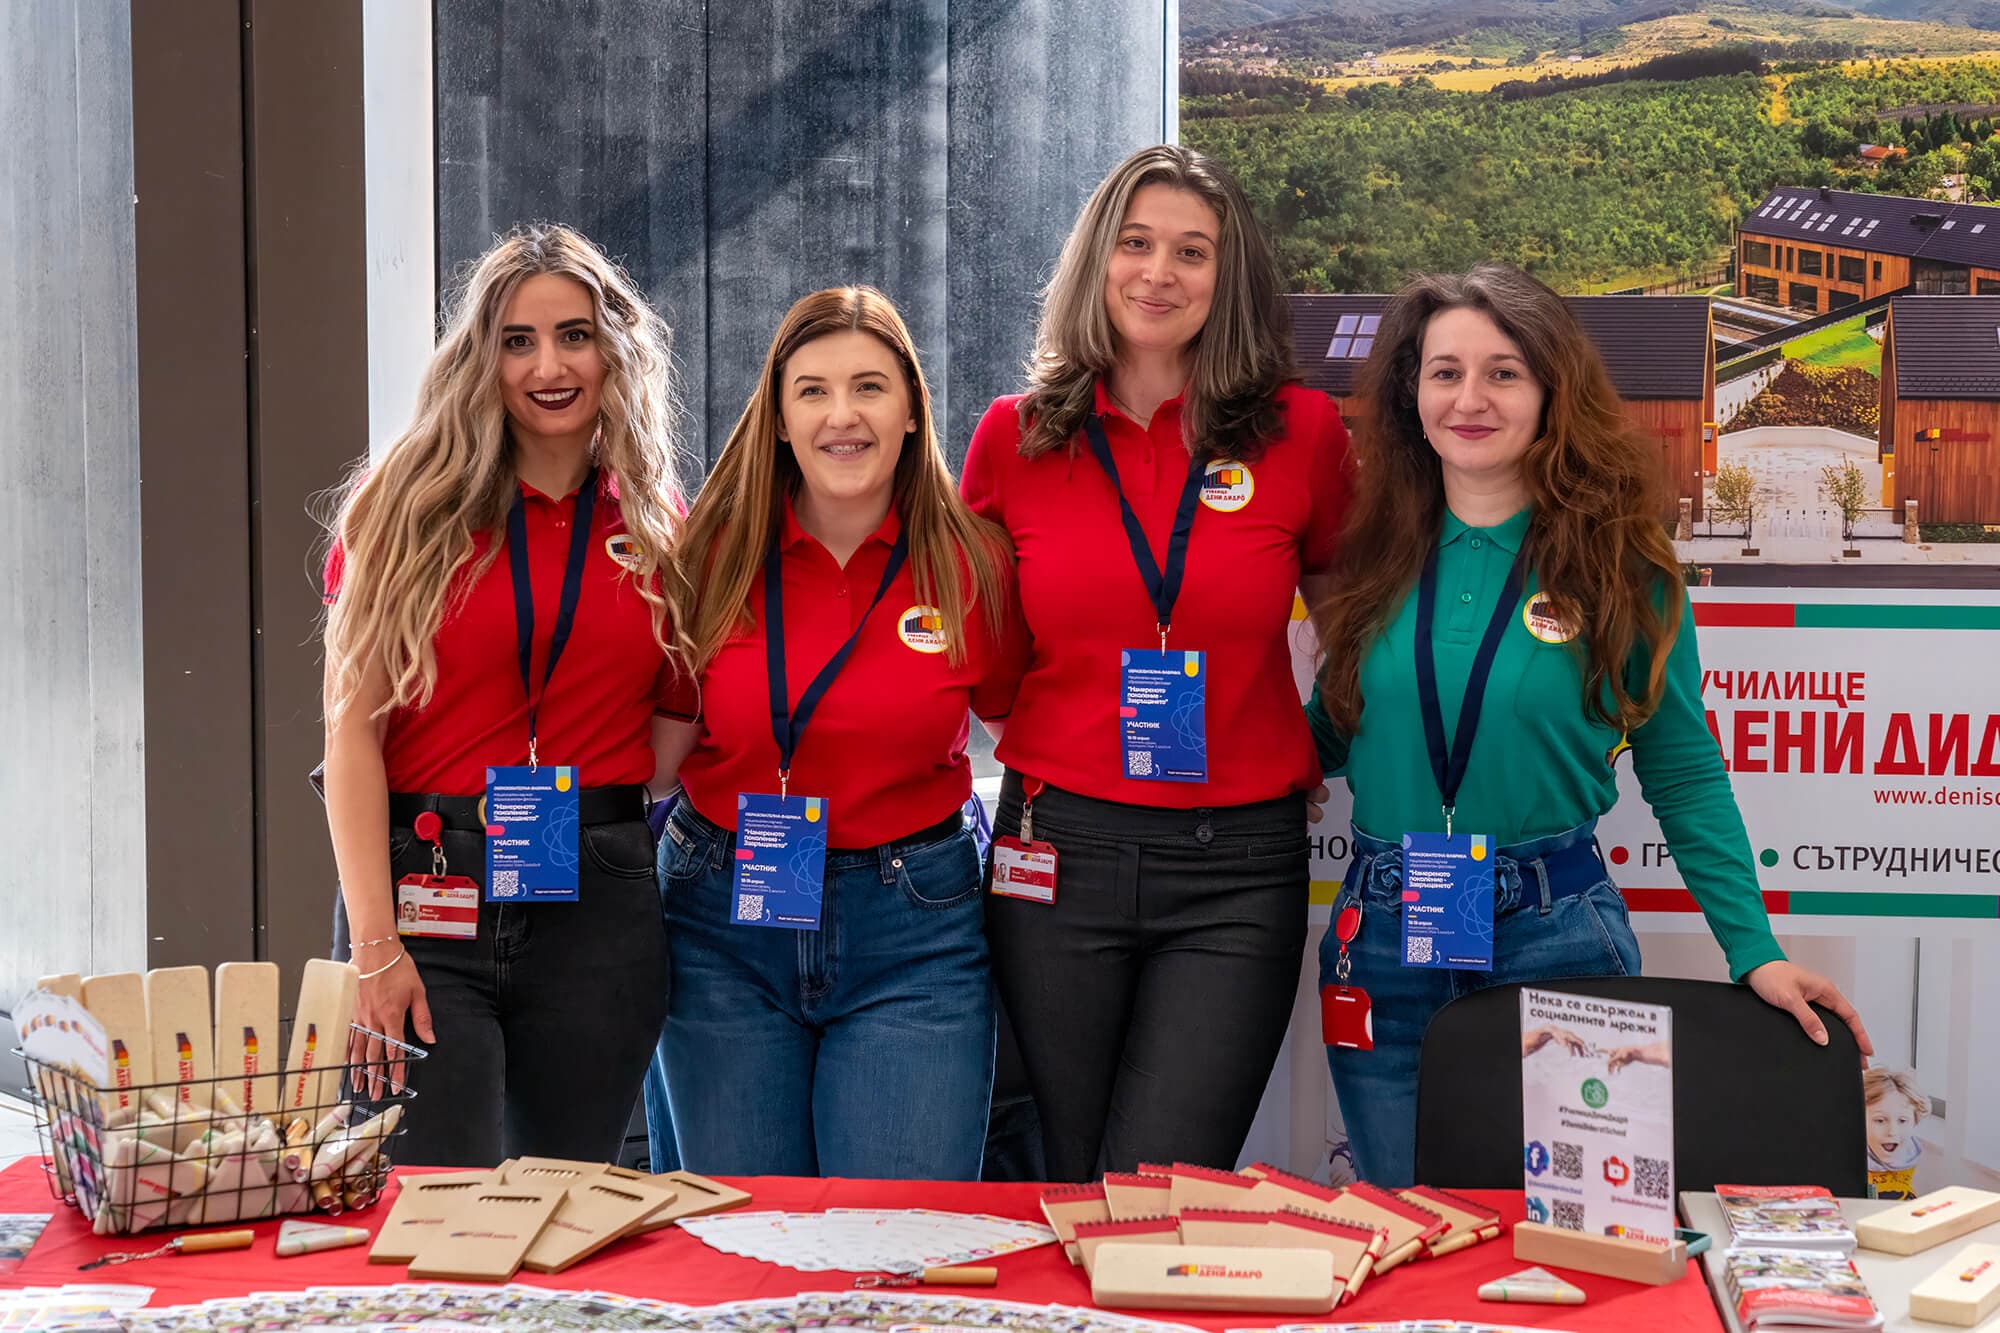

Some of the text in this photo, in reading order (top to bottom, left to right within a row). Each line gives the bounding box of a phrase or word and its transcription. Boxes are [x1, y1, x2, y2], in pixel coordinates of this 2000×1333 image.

[1126, 721, 1161, 729] УЧАСТНИК
[742, 863, 777, 873] УЧАСТНИК
[1408, 905, 1445, 914] УЧАСТНИК
[1529, 992, 1657, 1021] Нека се свържем в
[1530, 1007, 1657, 1035] социалните мрежи
